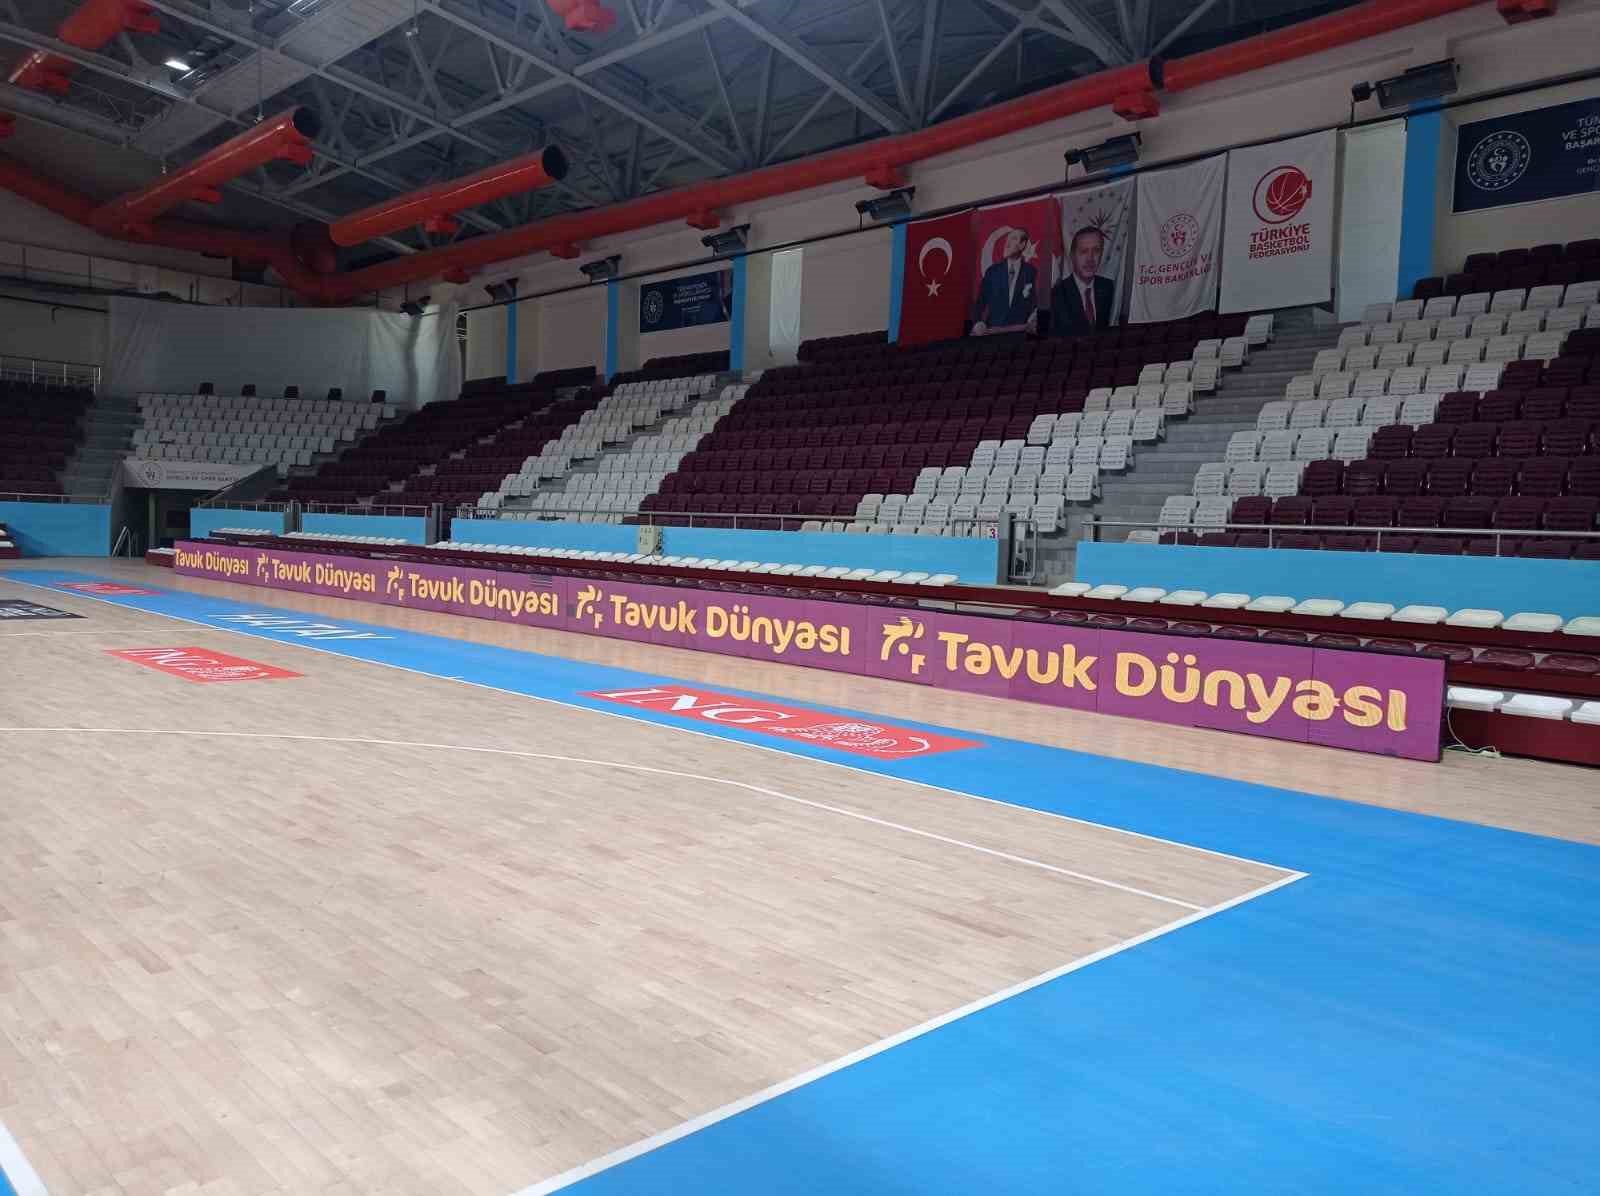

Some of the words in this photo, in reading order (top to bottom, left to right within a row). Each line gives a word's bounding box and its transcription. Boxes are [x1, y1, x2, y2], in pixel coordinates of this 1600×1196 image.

[1249, 235, 1311, 252] BASKETBOL
[1250, 223, 1311, 244] TÜRKİYE
[1248, 244, 1311, 260] FEDERASYONU
[1137, 275, 1163, 286] SPOR
[175, 549, 203, 569] Tavuk
[205, 551, 249, 577] Dünyası
[271, 558, 311, 584] Tavuk
[315, 563, 376, 593] Dünyası
[408, 572, 464, 604] Tavuk
[469, 579, 559, 617] Dünyası
[610, 594, 697, 635] Tavuk
[706, 604, 850, 656] Dünyası
[937, 630, 1098, 691] Tavuk
[1114, 651, 1408, 732] Dünyası
[596, 687, 796, 724] ING
